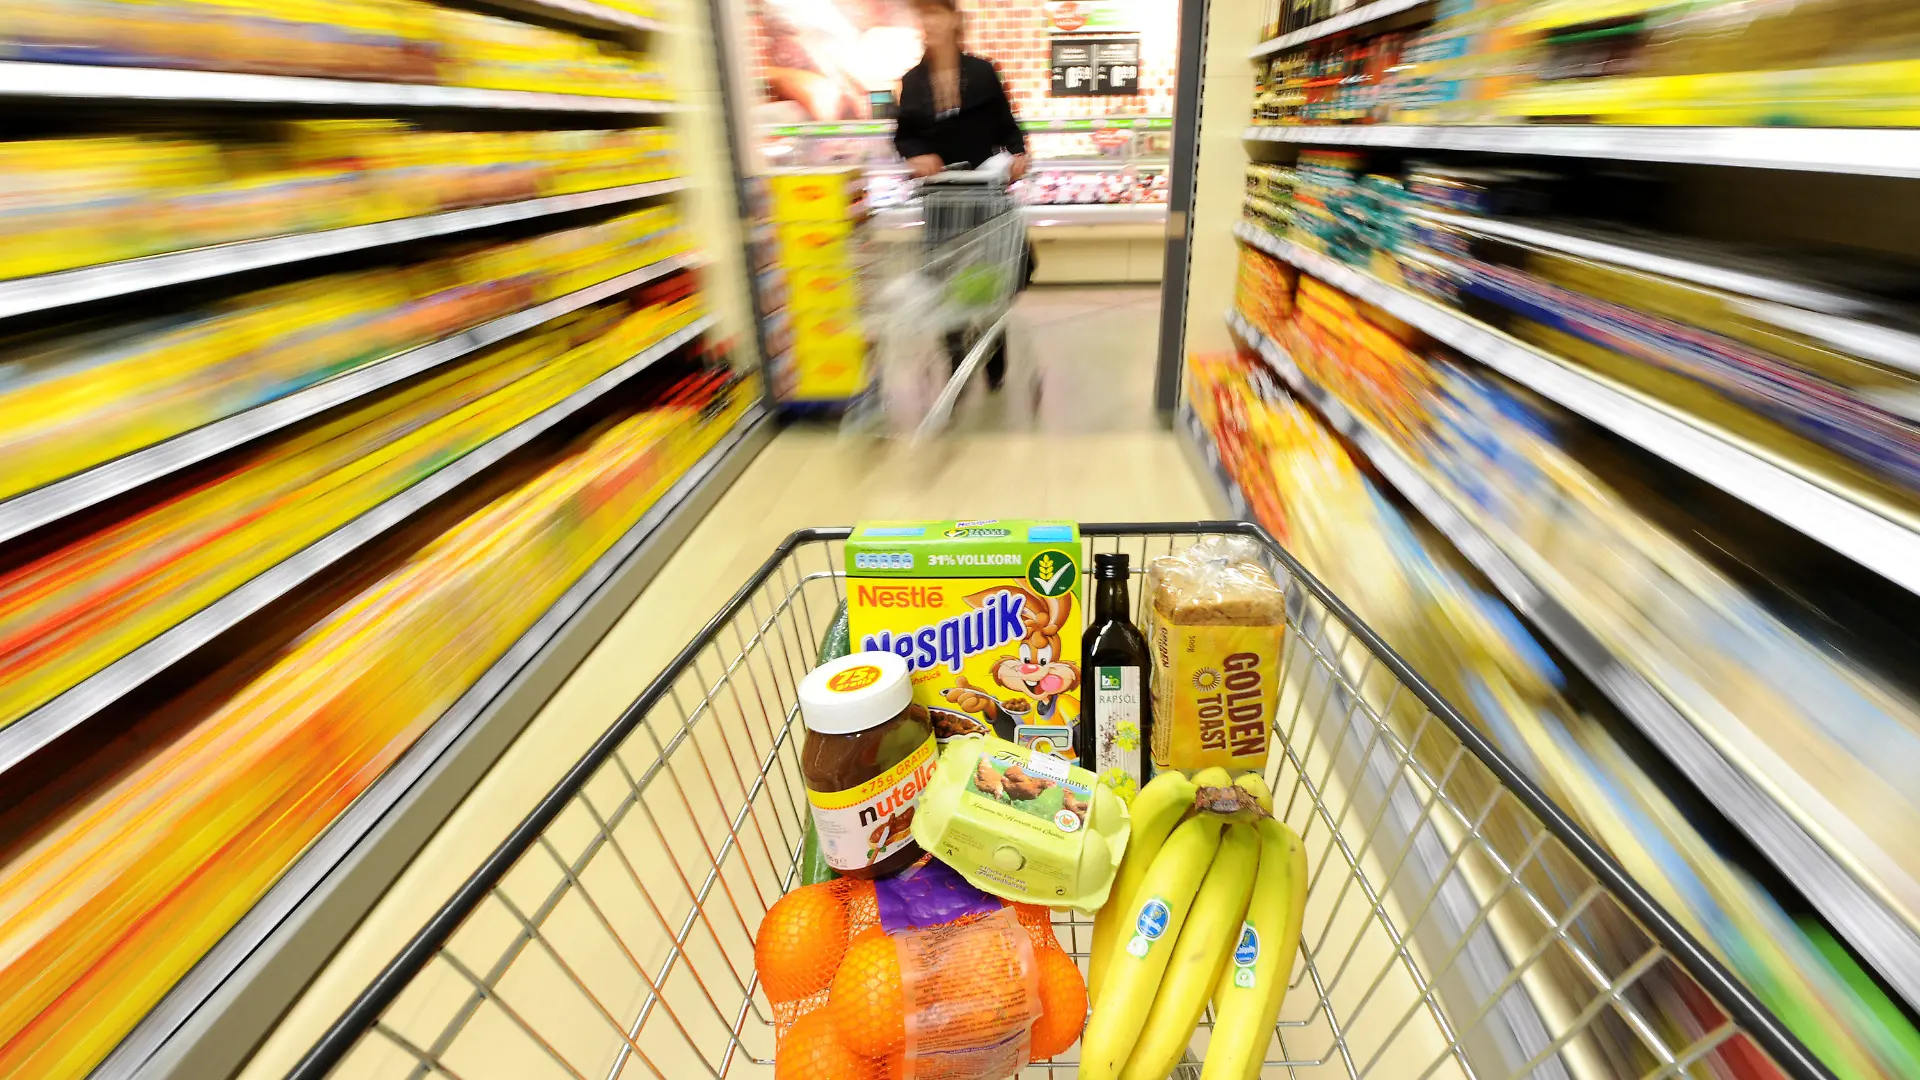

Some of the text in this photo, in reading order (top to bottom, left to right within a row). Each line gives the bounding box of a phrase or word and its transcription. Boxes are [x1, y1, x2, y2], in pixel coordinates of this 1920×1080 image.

[928, 554, 1022, 566] 31% VOLLKORN
[862, 592, 1025, 673] Nesquik
[1197, 693, 1227, 750] TOAST
[1223, 652, 1266, 757] GOLDEN
[896, 744, 929, 776] GRATIS
[859, 760, 937, 827] nutella
